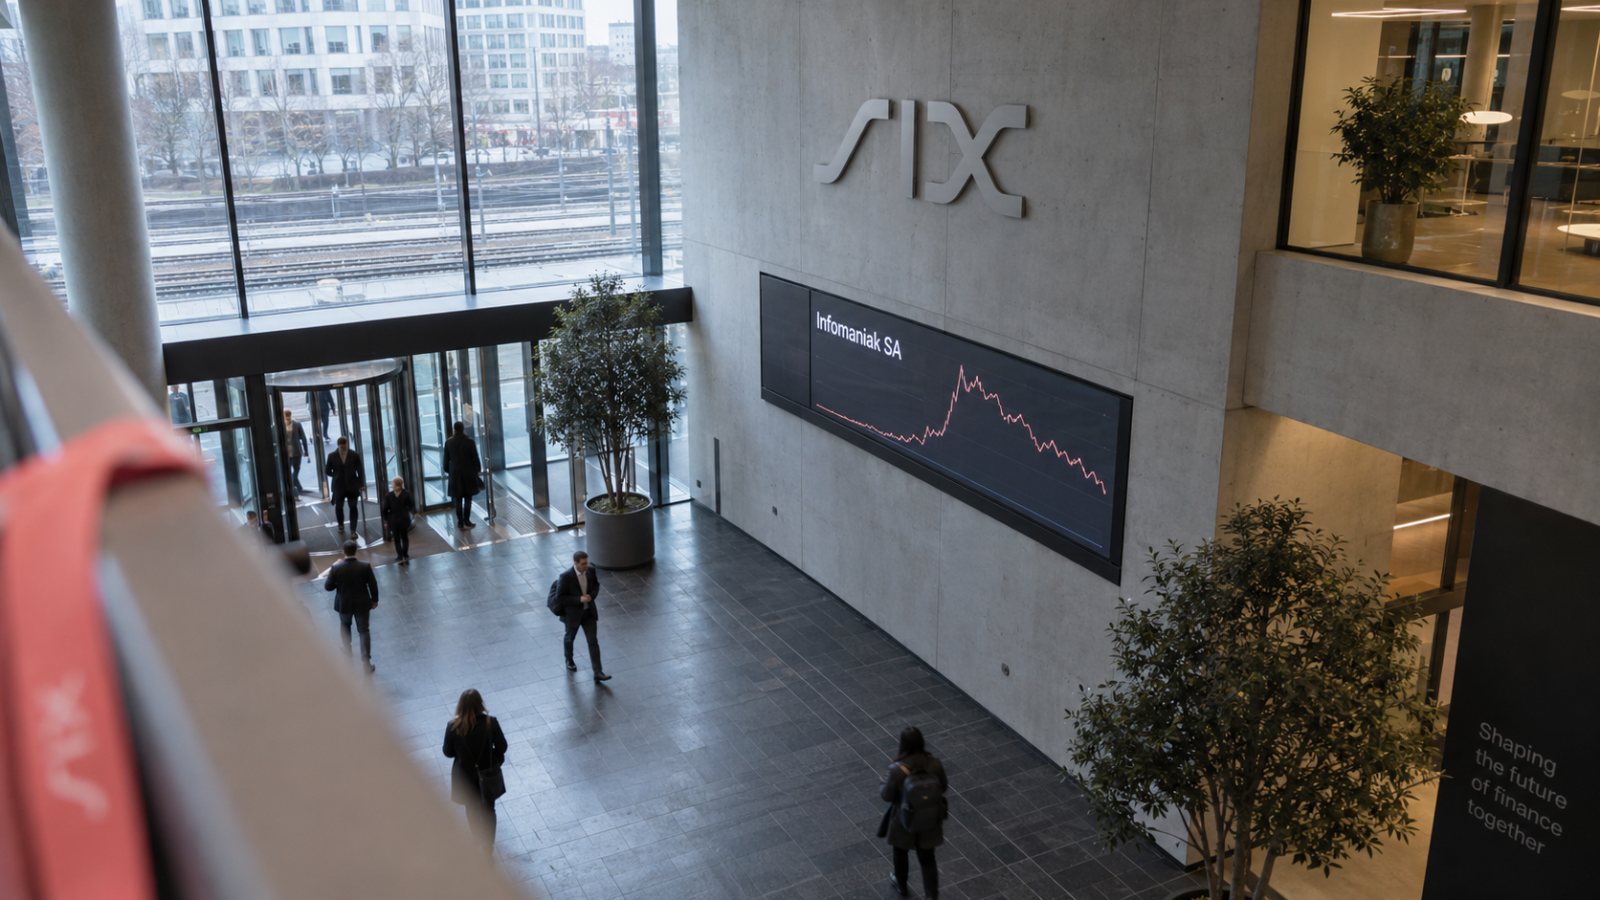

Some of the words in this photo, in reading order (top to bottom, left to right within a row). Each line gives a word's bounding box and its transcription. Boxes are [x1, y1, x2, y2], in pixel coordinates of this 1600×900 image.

[814, 98, 1029, 219] SIX
[816, 311, 881, 353] Infomaniak
[883, 335, 902, 361] SA
[1476, 748, 1505, 776] the
[1509, 765, 1568, 810] future
[1479, 722, 1557, 778] Shaping
[1467, 799, 1546, 854] together
[1471, 777, 1491, 796] of
[1494, 786, 1563, 837] finance
